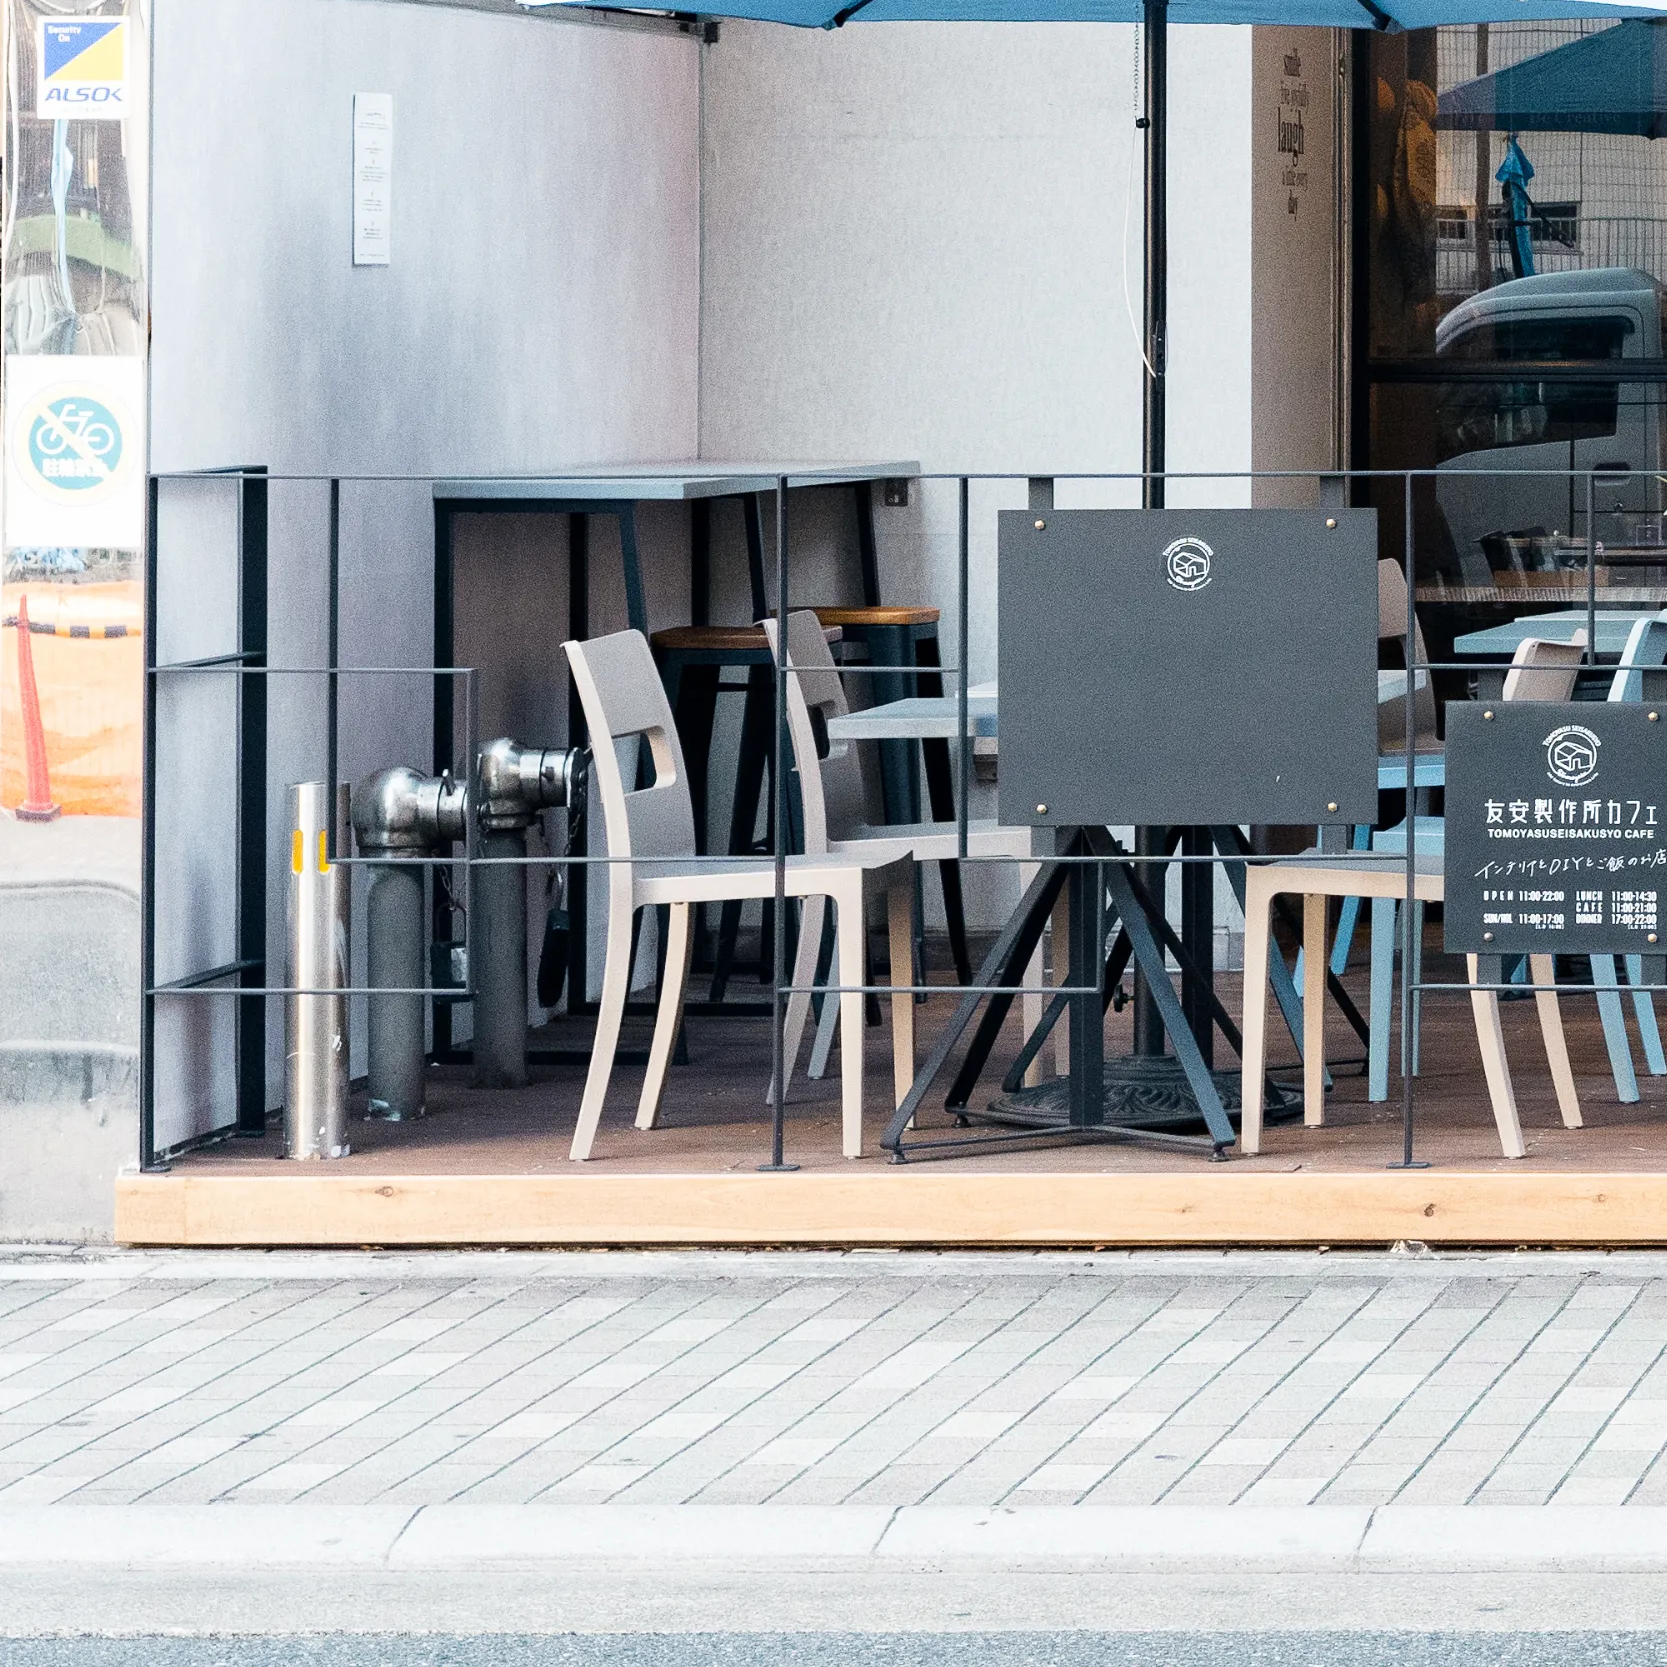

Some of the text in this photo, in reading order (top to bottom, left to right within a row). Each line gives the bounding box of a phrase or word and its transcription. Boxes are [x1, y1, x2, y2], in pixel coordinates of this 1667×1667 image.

[45, 87, 123, 102] ALSOK
[1484, 799, 1657, 824] 友安製作所カフェ
[1488, 829, 1654, 838] TOMOYASUSEISAKUSYO CAFE
[1484, 891, 1513, 901] OPEN
[1576, 891, 1602, 901] LUNCH
[1576, 902, 1602, 912] CAFE
